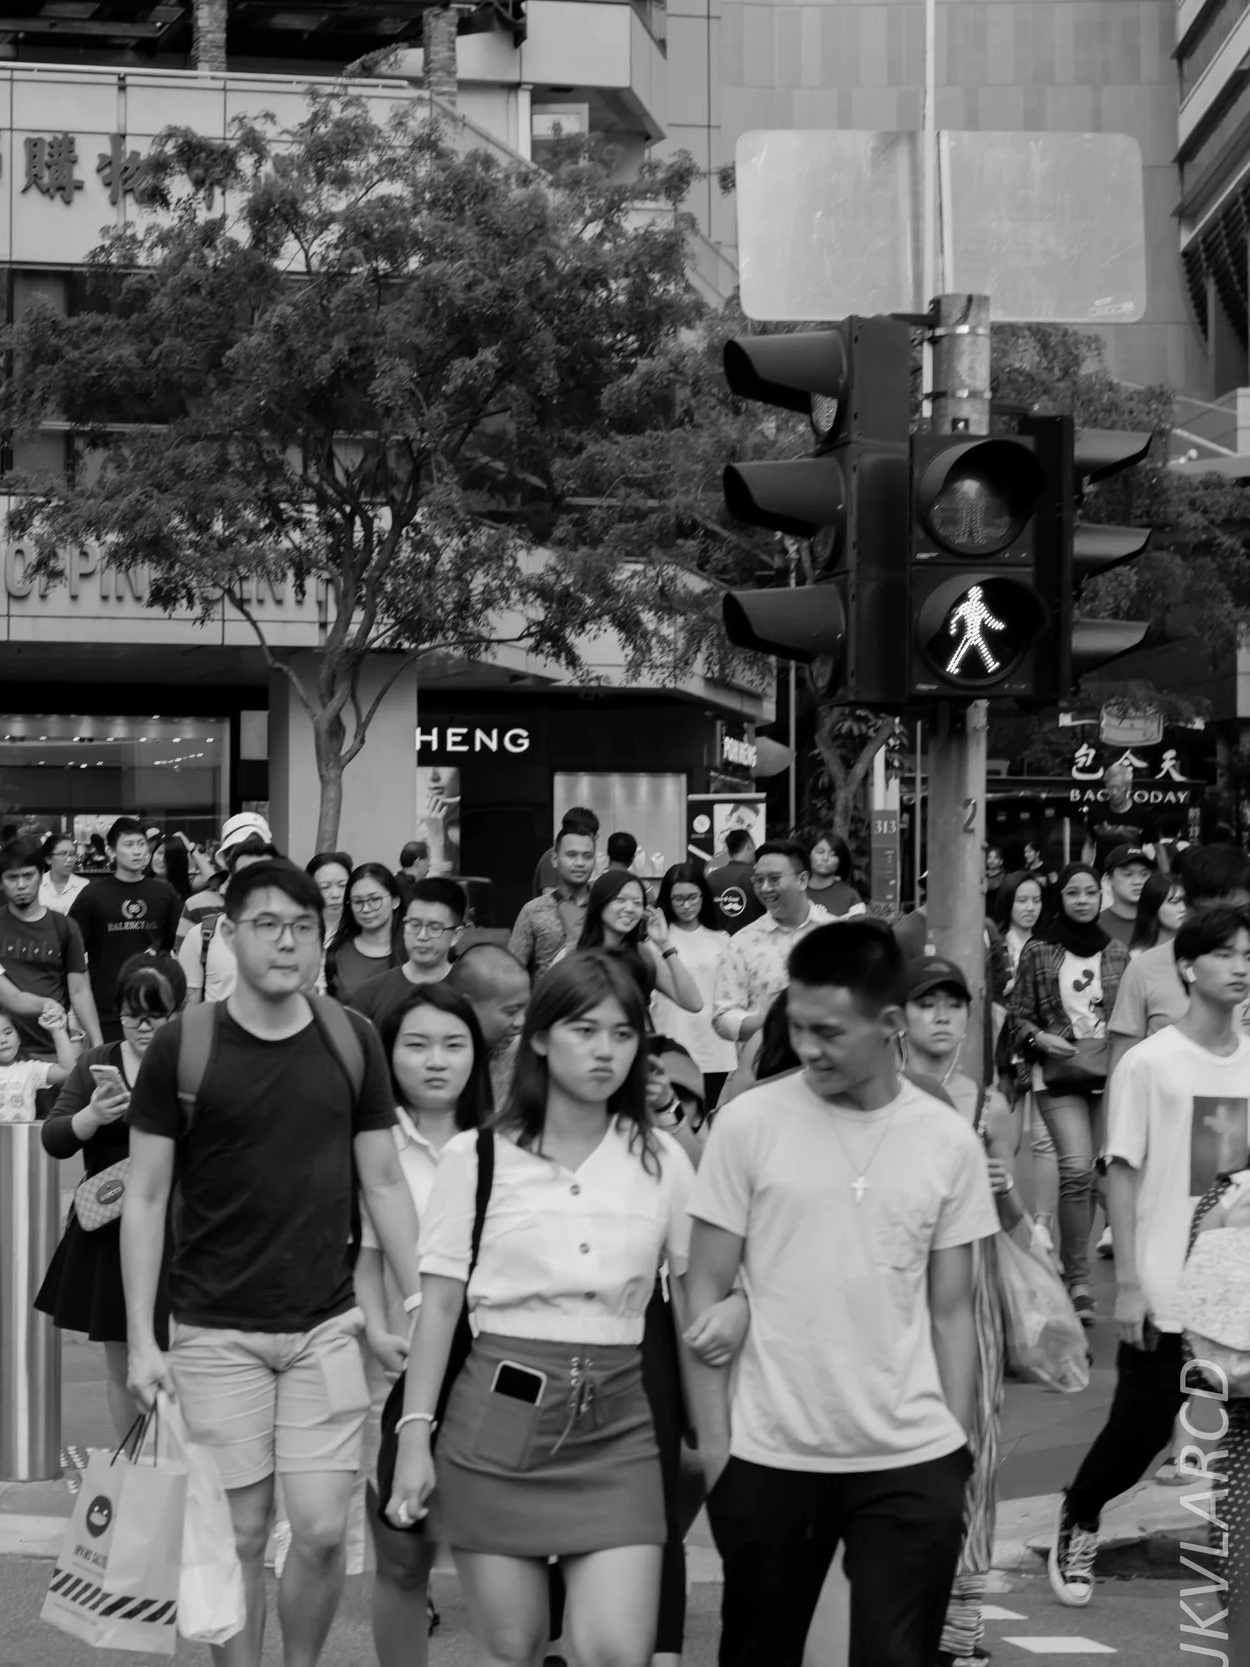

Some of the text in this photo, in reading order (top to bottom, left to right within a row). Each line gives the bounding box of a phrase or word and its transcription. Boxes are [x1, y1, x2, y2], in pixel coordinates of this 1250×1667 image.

[415, 727, 530, 753] HENG
[1125, 789, 1190, 804] ODAY
[962, 797, 978, 835] 2
[872, 819, 898, 834] 313
[107, 919, 158, 932] BALENCIAG
